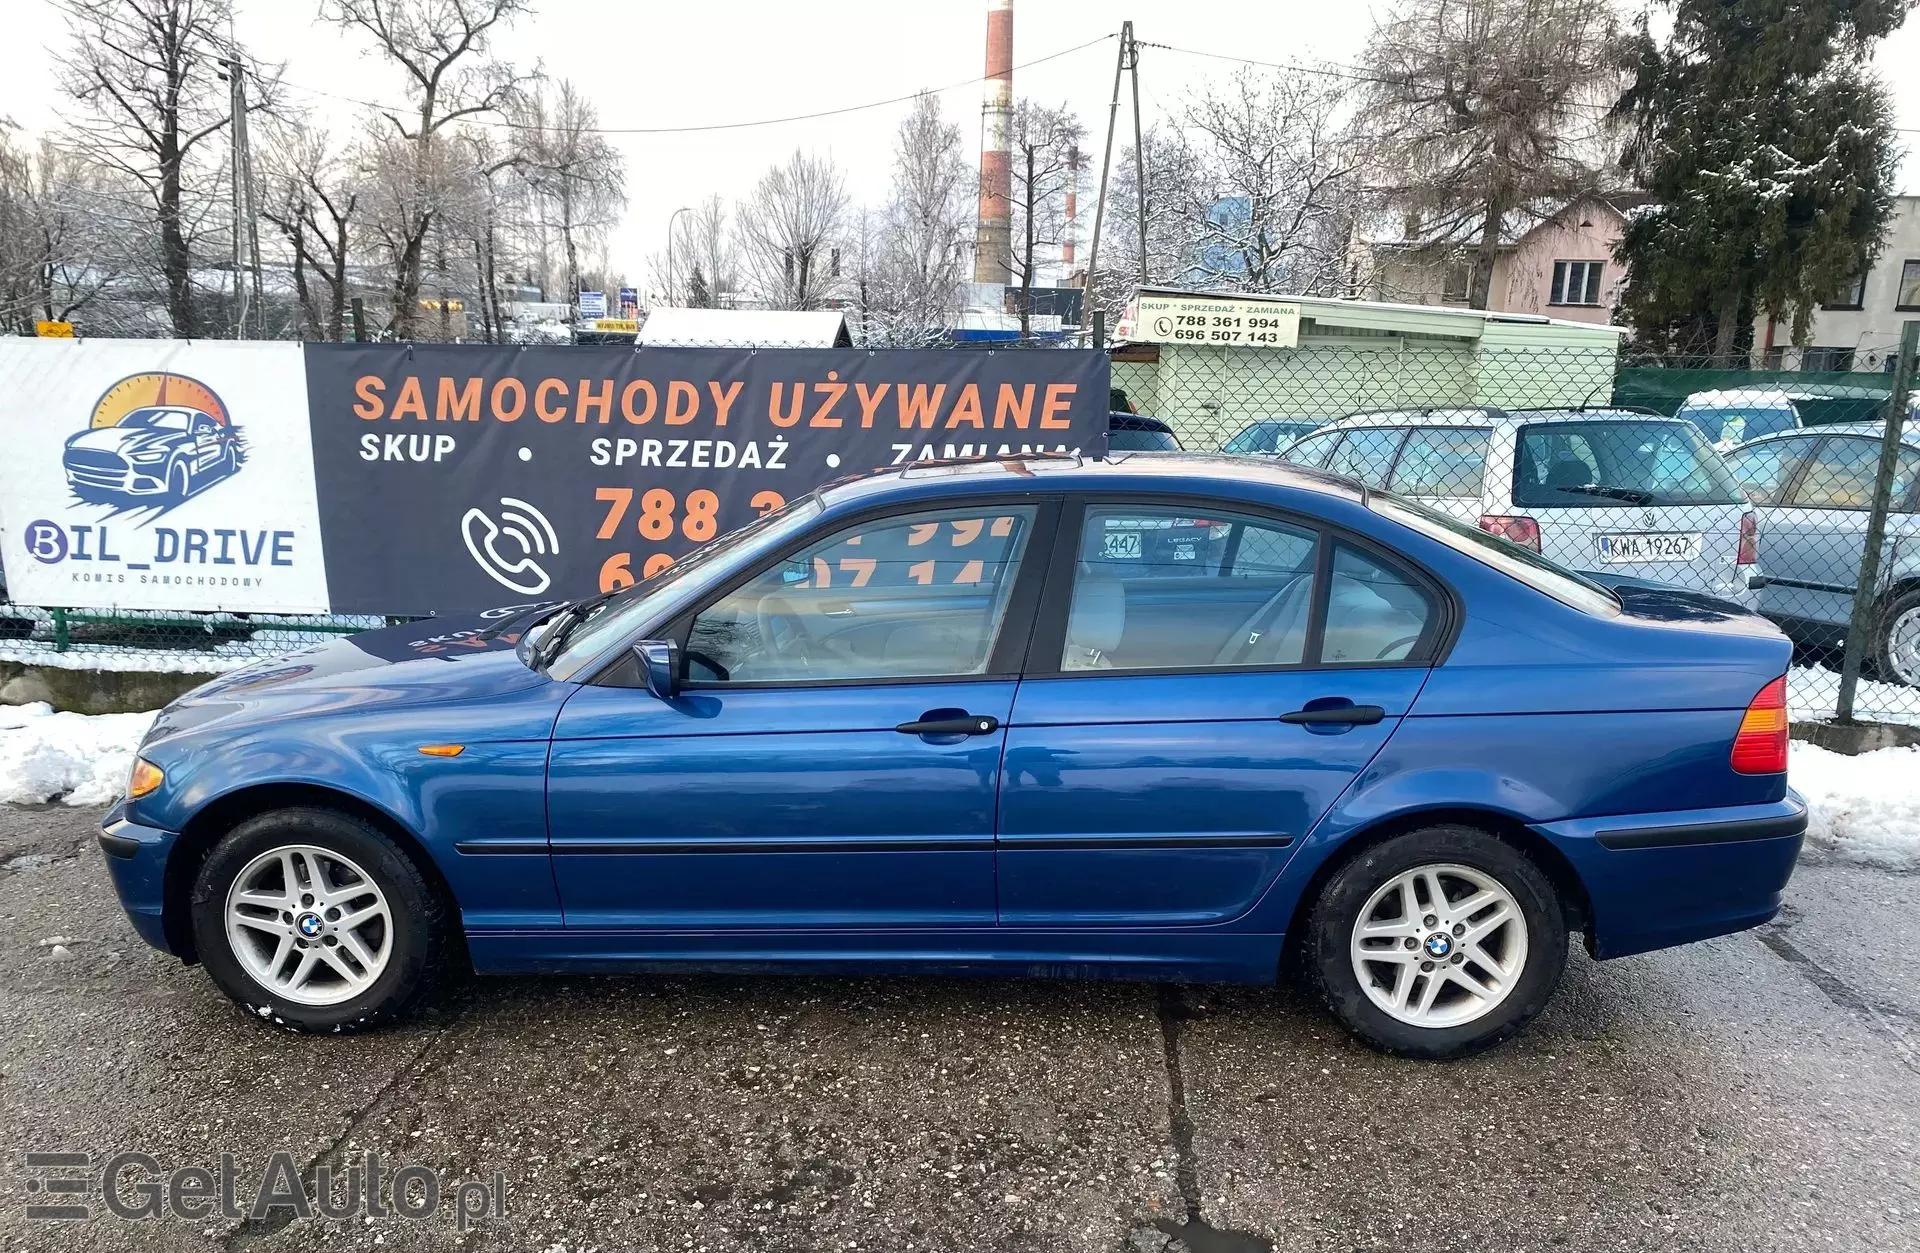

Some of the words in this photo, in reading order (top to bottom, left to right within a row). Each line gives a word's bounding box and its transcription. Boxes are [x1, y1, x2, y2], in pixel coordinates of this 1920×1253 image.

[1141, 302, 1170, 311] SKUP
[1180, 304, 1236, 313] SPRZEDAŻ
[1246, 306, 1295, 315] ZAMIANA
[1176, 315, 1206, 327] 788
[1212, 316, 1242, 328] 361
[1248, 317, 1279, 329] 994
[1174, 329, 1205, 341] 696
[1210, 331, 1240, 342] 507
[1248, 332, 1278, 343] 143
[353, 375, 744, 426] SAMOCHODY
[768, 371, 1078, 429] UŻYWANE
[359, 433, 456, 462] SKUP
[589, 435, 789, 469] SPRZEDAŻ
[595, 487, 720, 542] 788
[1609, 538, 1641, 556] KWA
[1646, 537, 1689, 555] 19267
[72, 573, 125, 583] KOMIS
[140, 574, 262, 587] SAMOCHODOWY
